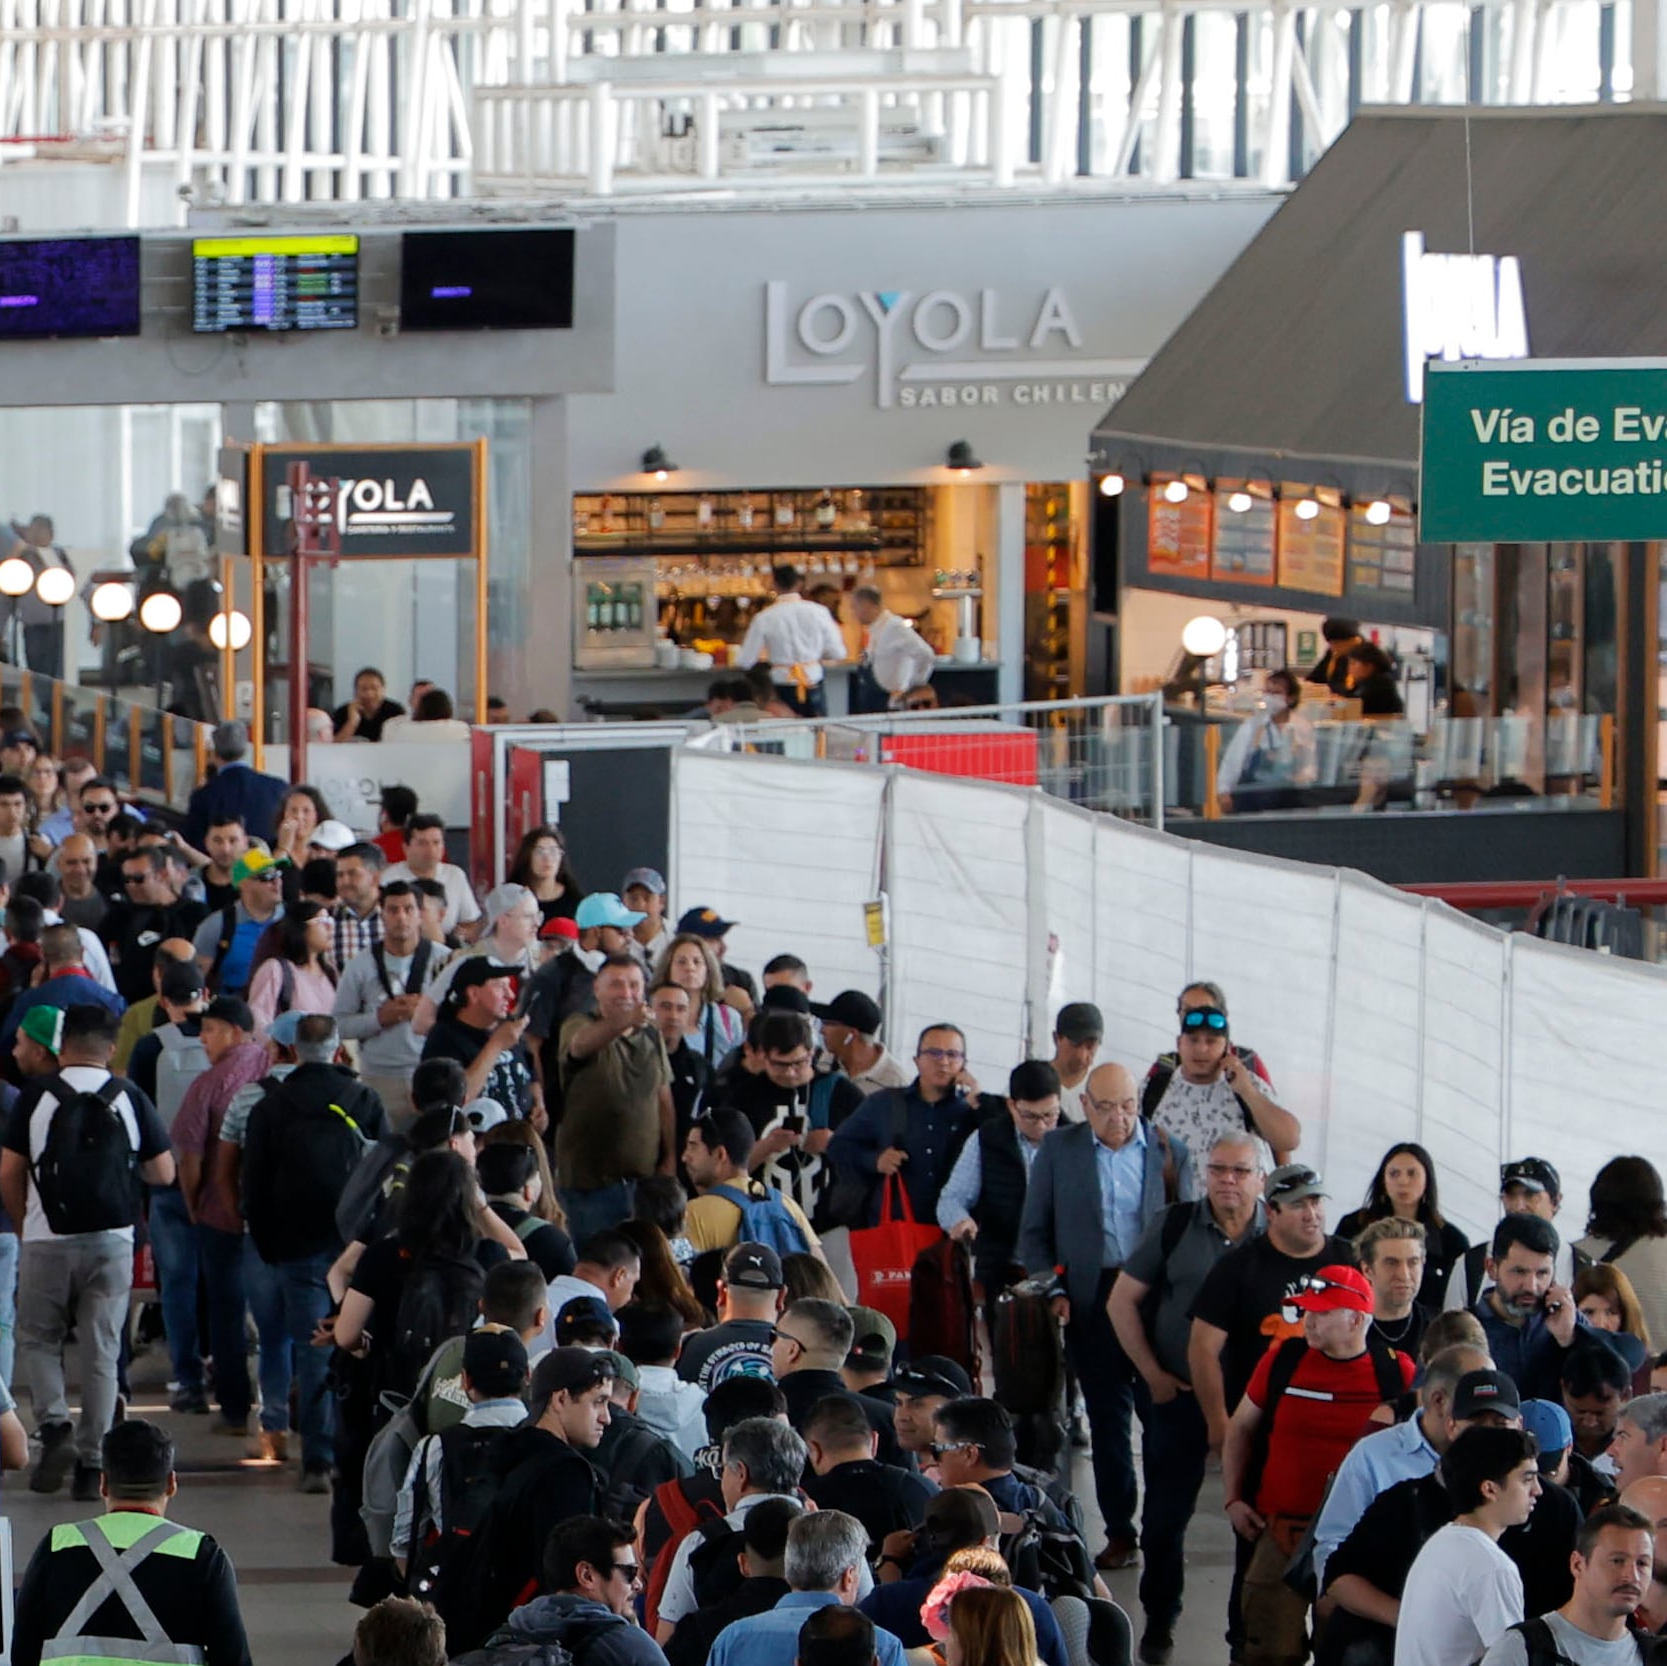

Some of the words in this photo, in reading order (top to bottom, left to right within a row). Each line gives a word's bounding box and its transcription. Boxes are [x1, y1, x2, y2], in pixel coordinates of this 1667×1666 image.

[767, 281, 1083, 408] LOYOLA
[900, 385, 999, 407] SABOR
[1471, 407, 1535, 443] Vía
[1548, 408, 1600, 443] de
[1614, 406, 1667, 442] Ev
[1483, 459, 1667, 496] Evacuati
